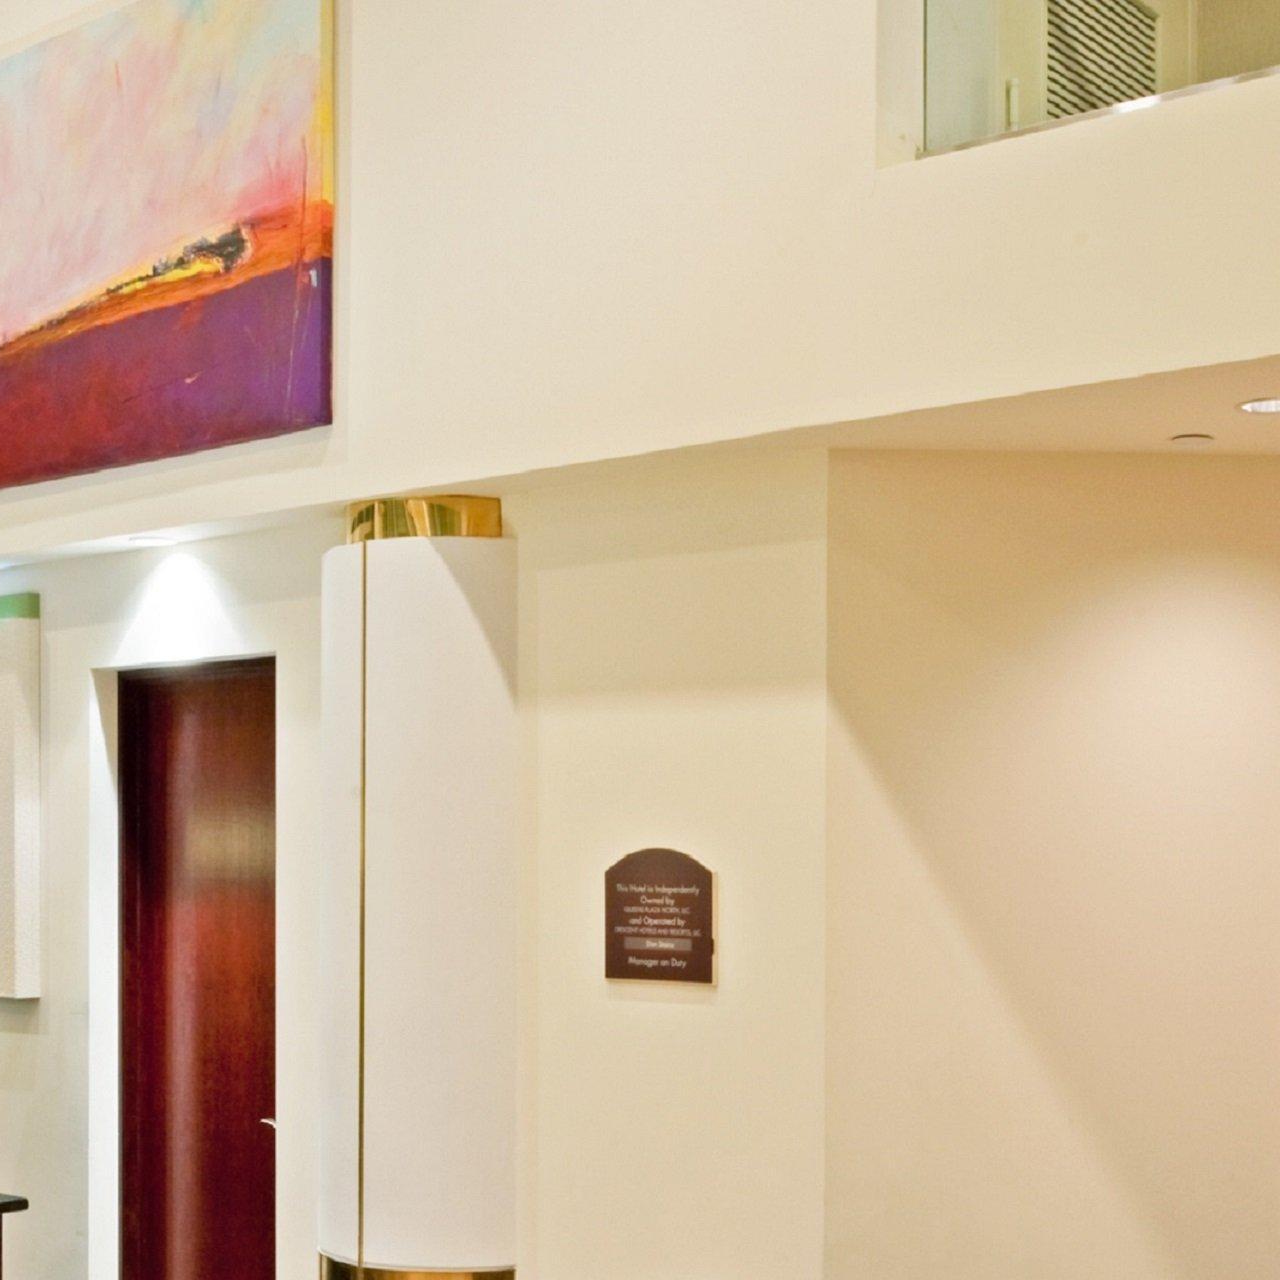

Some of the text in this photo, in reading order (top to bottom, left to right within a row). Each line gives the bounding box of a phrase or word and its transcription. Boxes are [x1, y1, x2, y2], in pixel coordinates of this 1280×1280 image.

[629, 884, 646, 893] Hotel
[655, 885, 700, 896] Independently
[640, 895, 675, 906] Owned by
[629, 915, 686, 927] and Operated by
[628, 956, 687, 968] Manager on Duty
